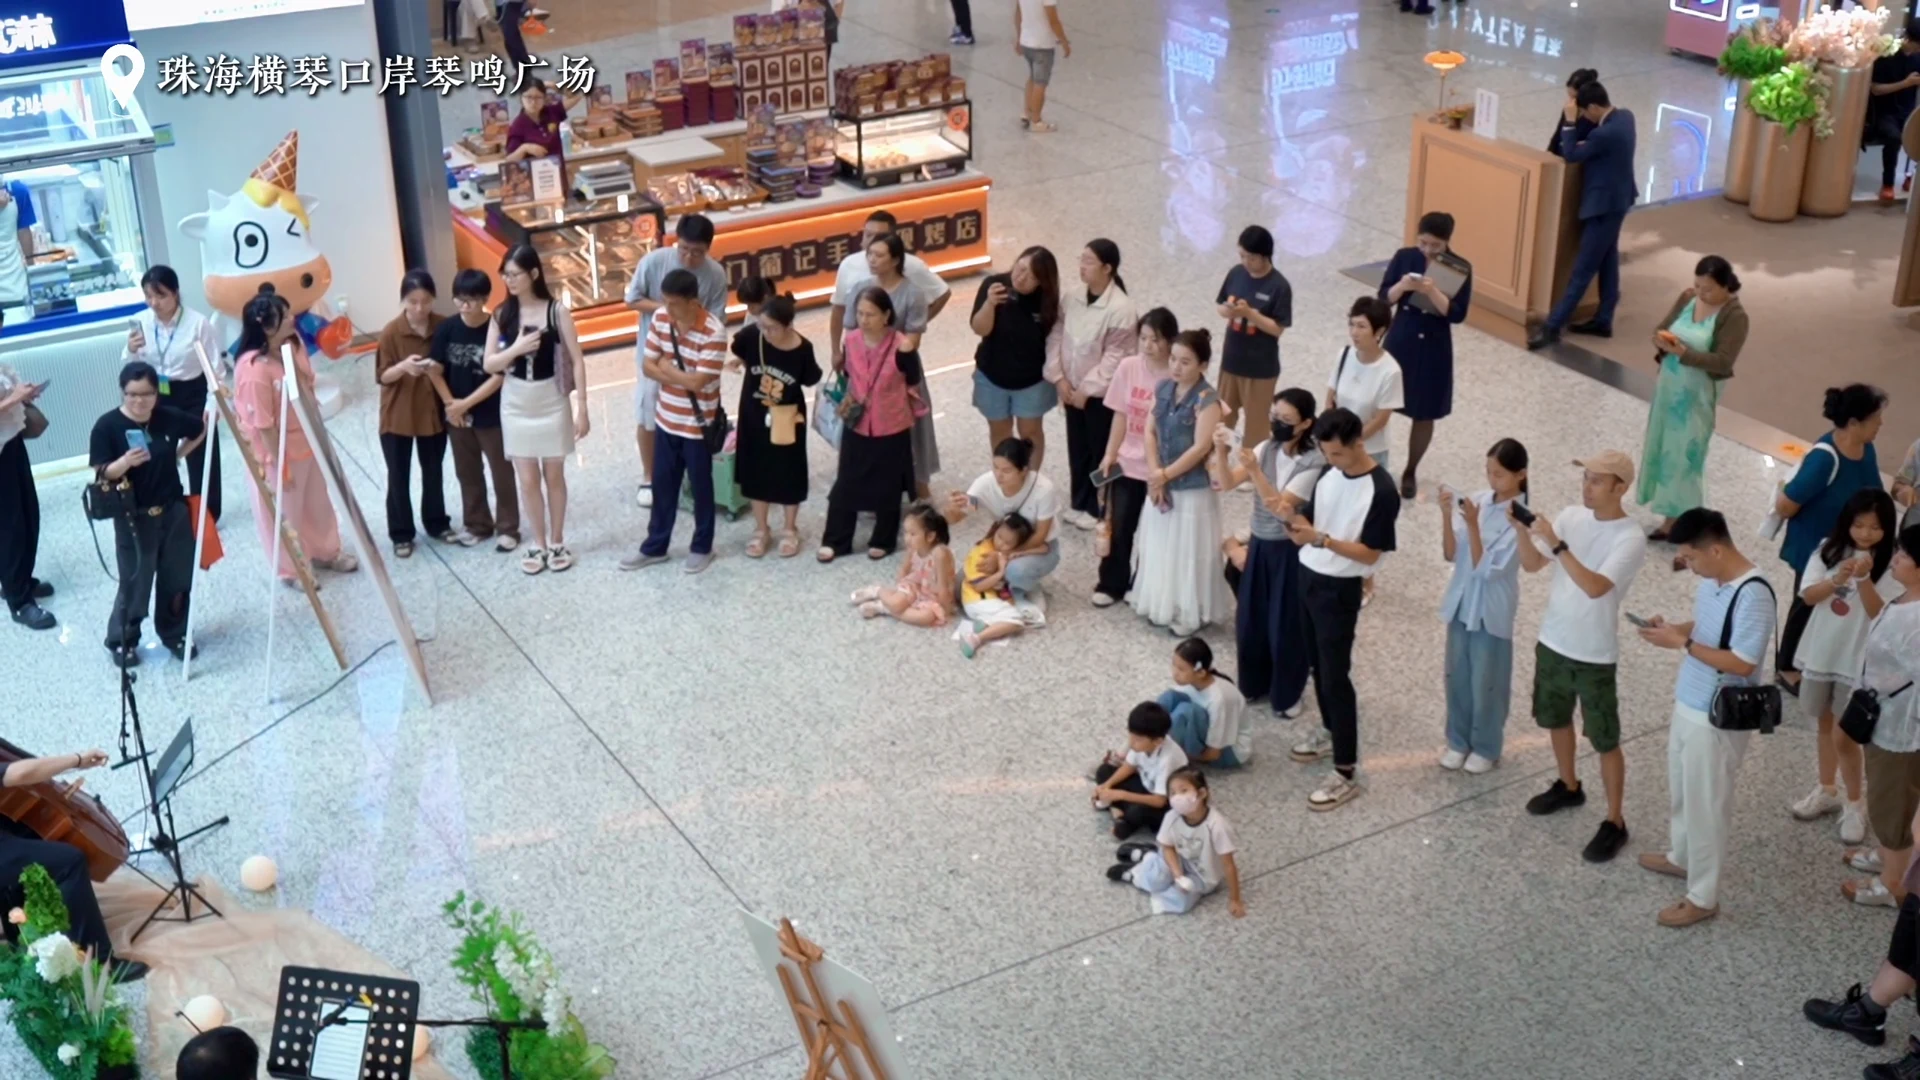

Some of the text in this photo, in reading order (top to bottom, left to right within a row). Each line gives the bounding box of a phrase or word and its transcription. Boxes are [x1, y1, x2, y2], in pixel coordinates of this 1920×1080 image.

[726, 216, 977, 286] 门葡记手现烤店
[759, 374, 785, 399] 92
